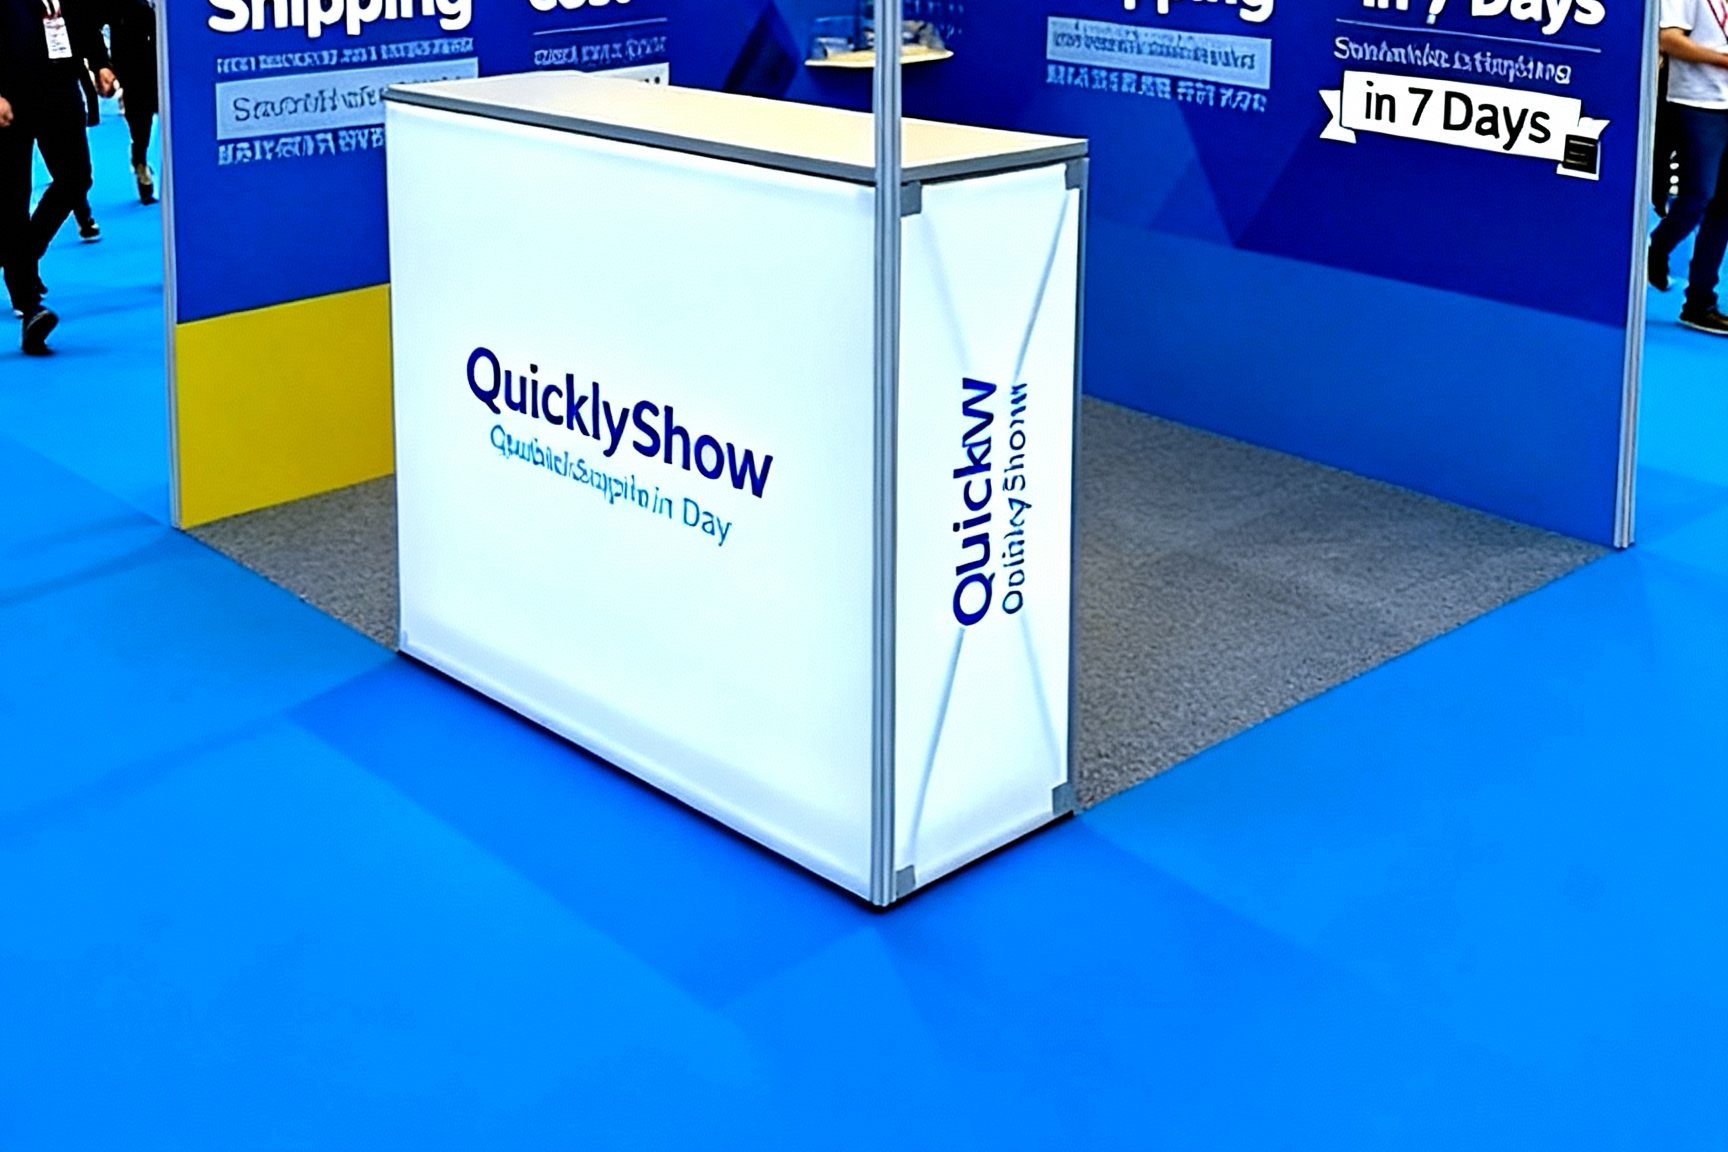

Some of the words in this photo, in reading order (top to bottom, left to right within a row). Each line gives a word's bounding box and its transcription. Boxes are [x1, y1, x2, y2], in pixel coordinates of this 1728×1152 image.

[1364, 80, 1396, 124] in
[1408, 86, 1434, 127] 7
[1443, 90, 1552, 152] Days
[466, 346, 774, 499] QuicklyShow
[682, 497, 733, 547] Day
